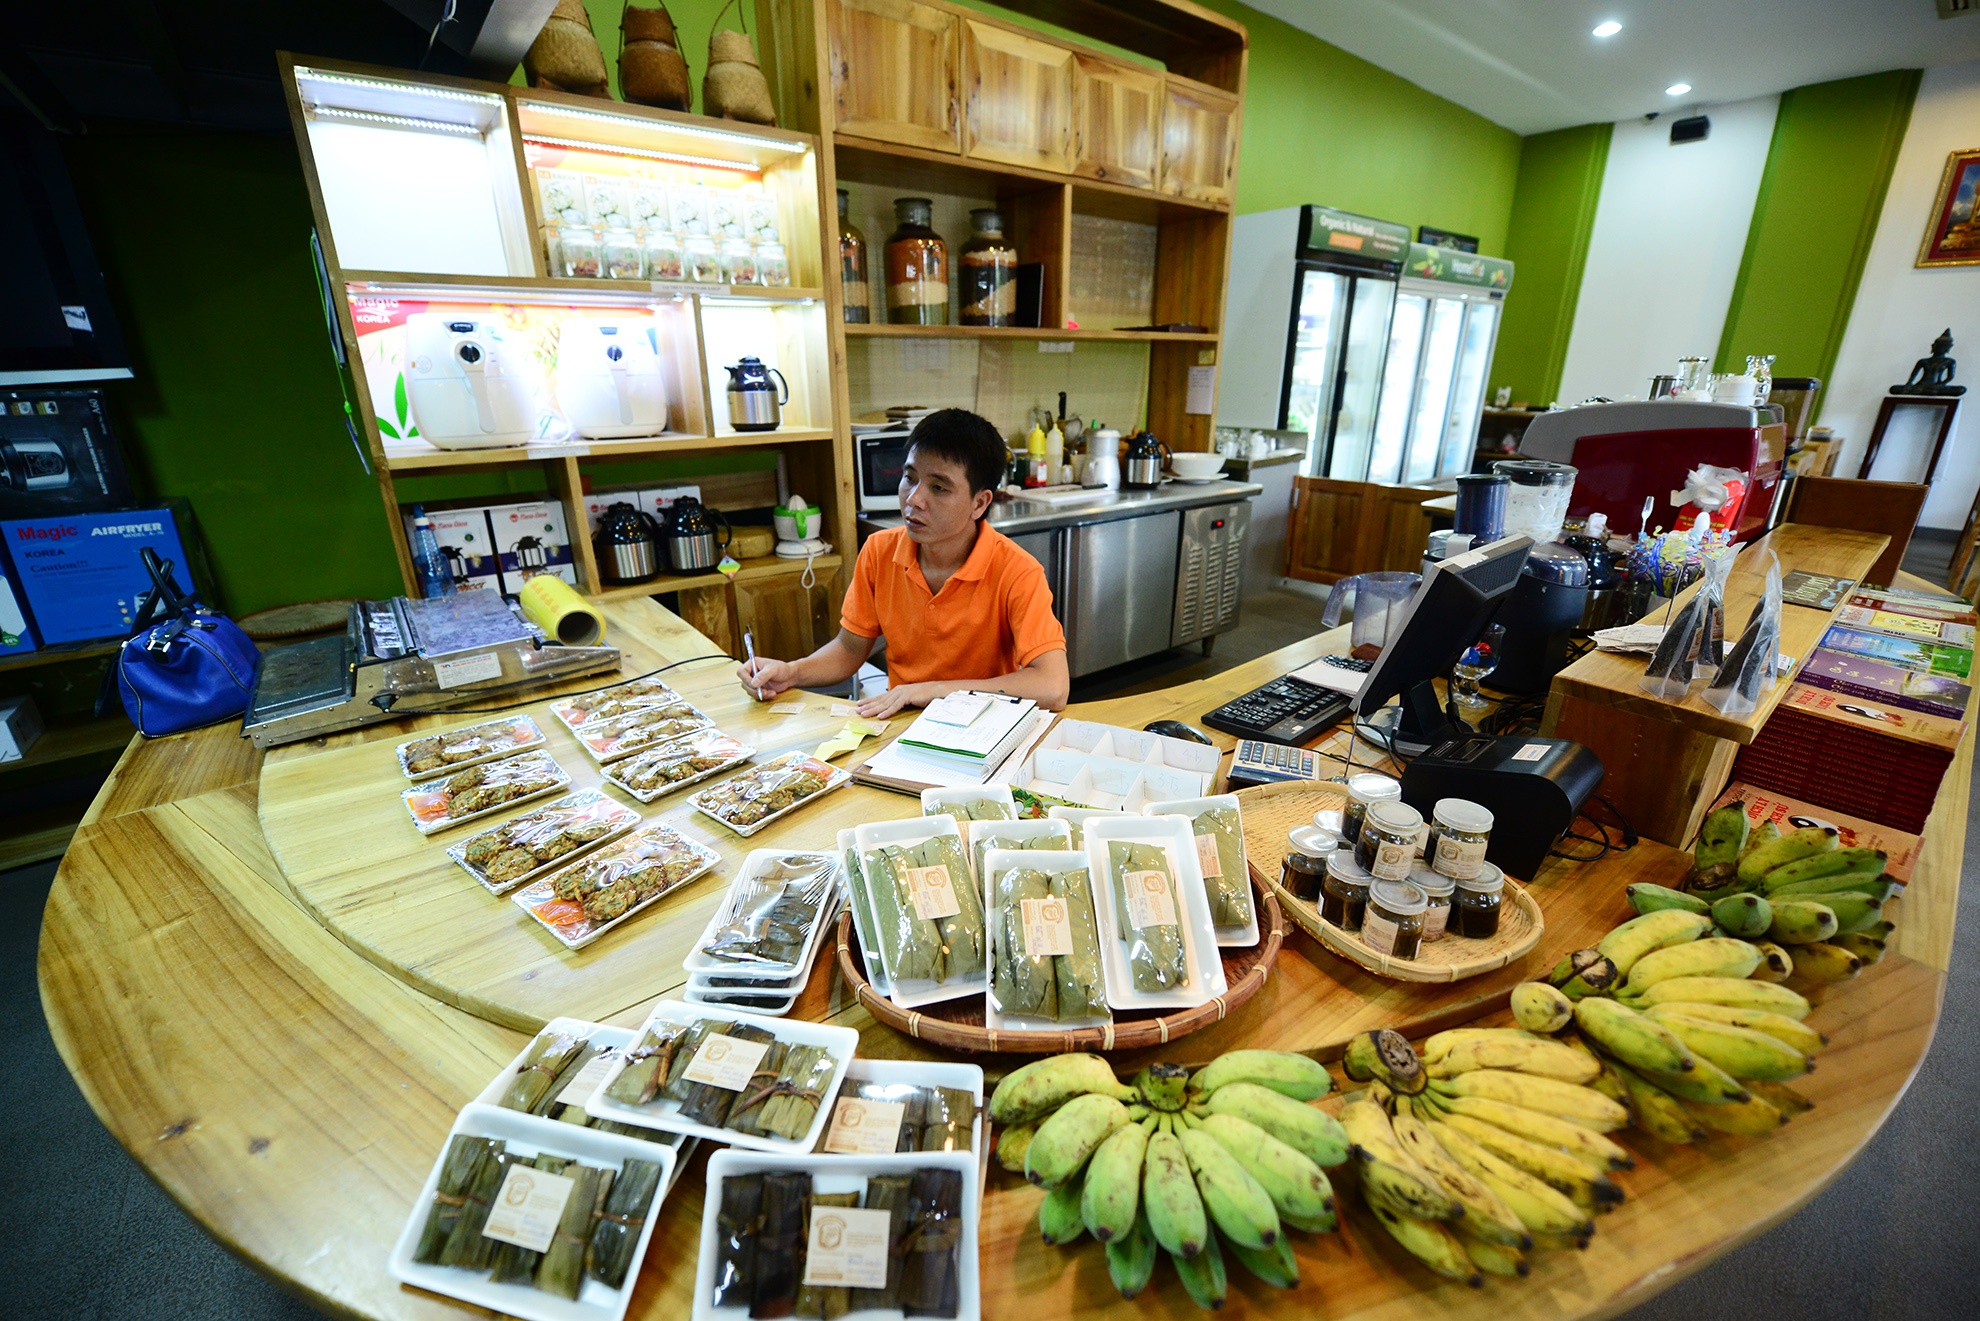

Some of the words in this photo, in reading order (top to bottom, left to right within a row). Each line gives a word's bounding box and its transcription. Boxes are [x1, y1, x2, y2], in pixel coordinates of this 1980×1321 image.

[356, 314, 390, 324] KOREA
[17, 524, 78, 541] Magic
[91, 522, 162, 536] AIRFRYER
[25, 549, 65, 559] KOREA
[30, 560, 88, 573] Caution!!!
[1754, 796, 1770, 807] LÝ
[1748, 805, 1765, 819] DỊCH
